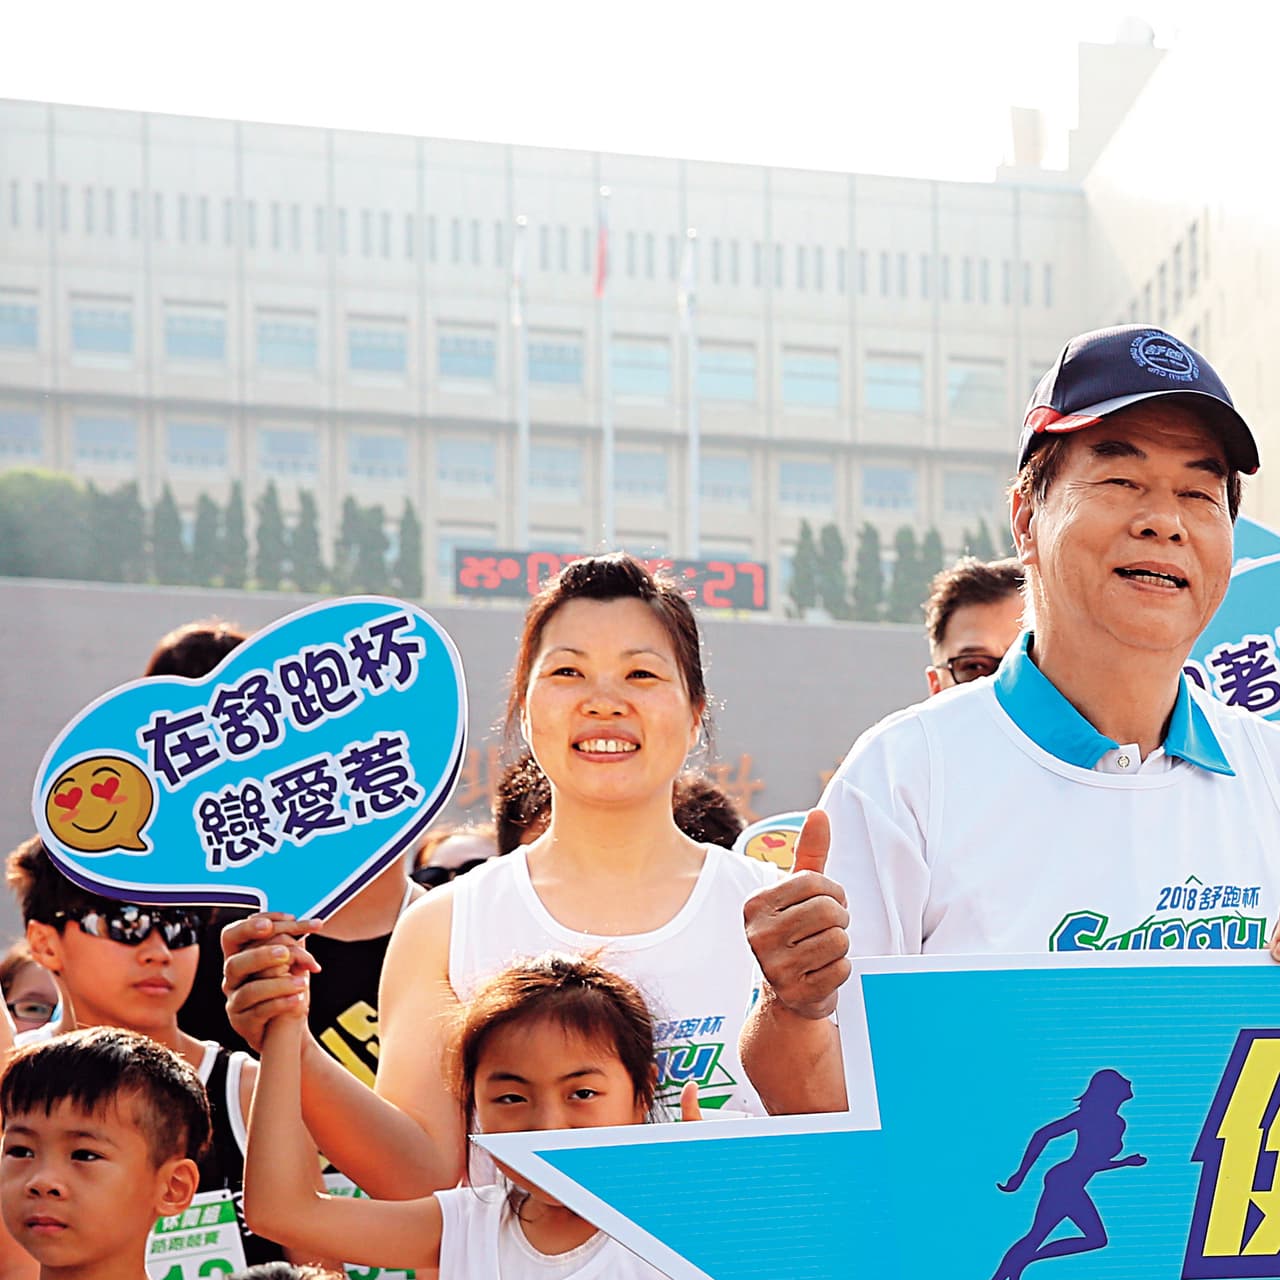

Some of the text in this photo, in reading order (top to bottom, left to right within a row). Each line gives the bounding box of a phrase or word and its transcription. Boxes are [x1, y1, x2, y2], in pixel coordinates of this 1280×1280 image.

[144, 614, 422, 784] 在舒跑杯
[200, 735, 418, 868] 戀愛惹
[1156, 886, 1261, 911] 2018 舒跑杯
